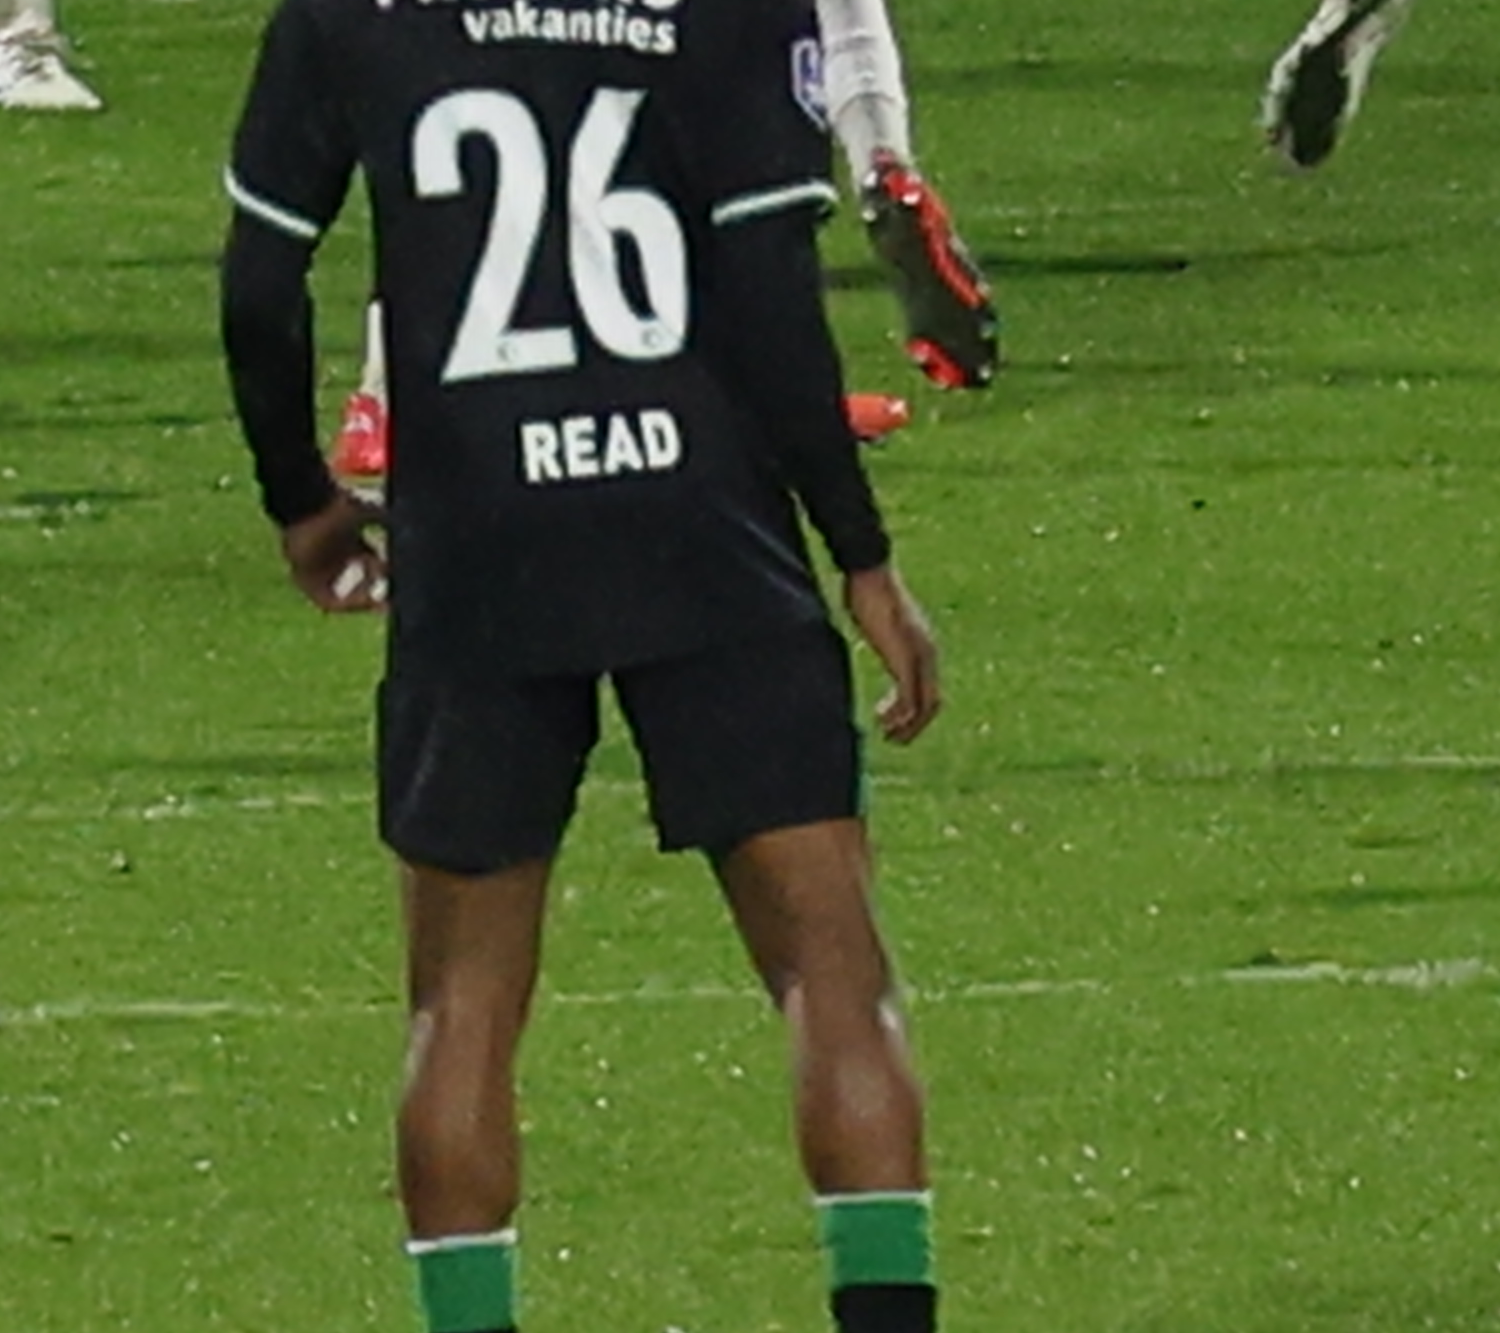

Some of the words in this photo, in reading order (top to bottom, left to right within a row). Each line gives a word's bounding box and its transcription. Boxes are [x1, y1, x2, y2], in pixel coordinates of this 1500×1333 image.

[462, 0, 677, 54] vakanties
[411, 86, 689, 385] 26
[519, 409, 683, 485] READ
